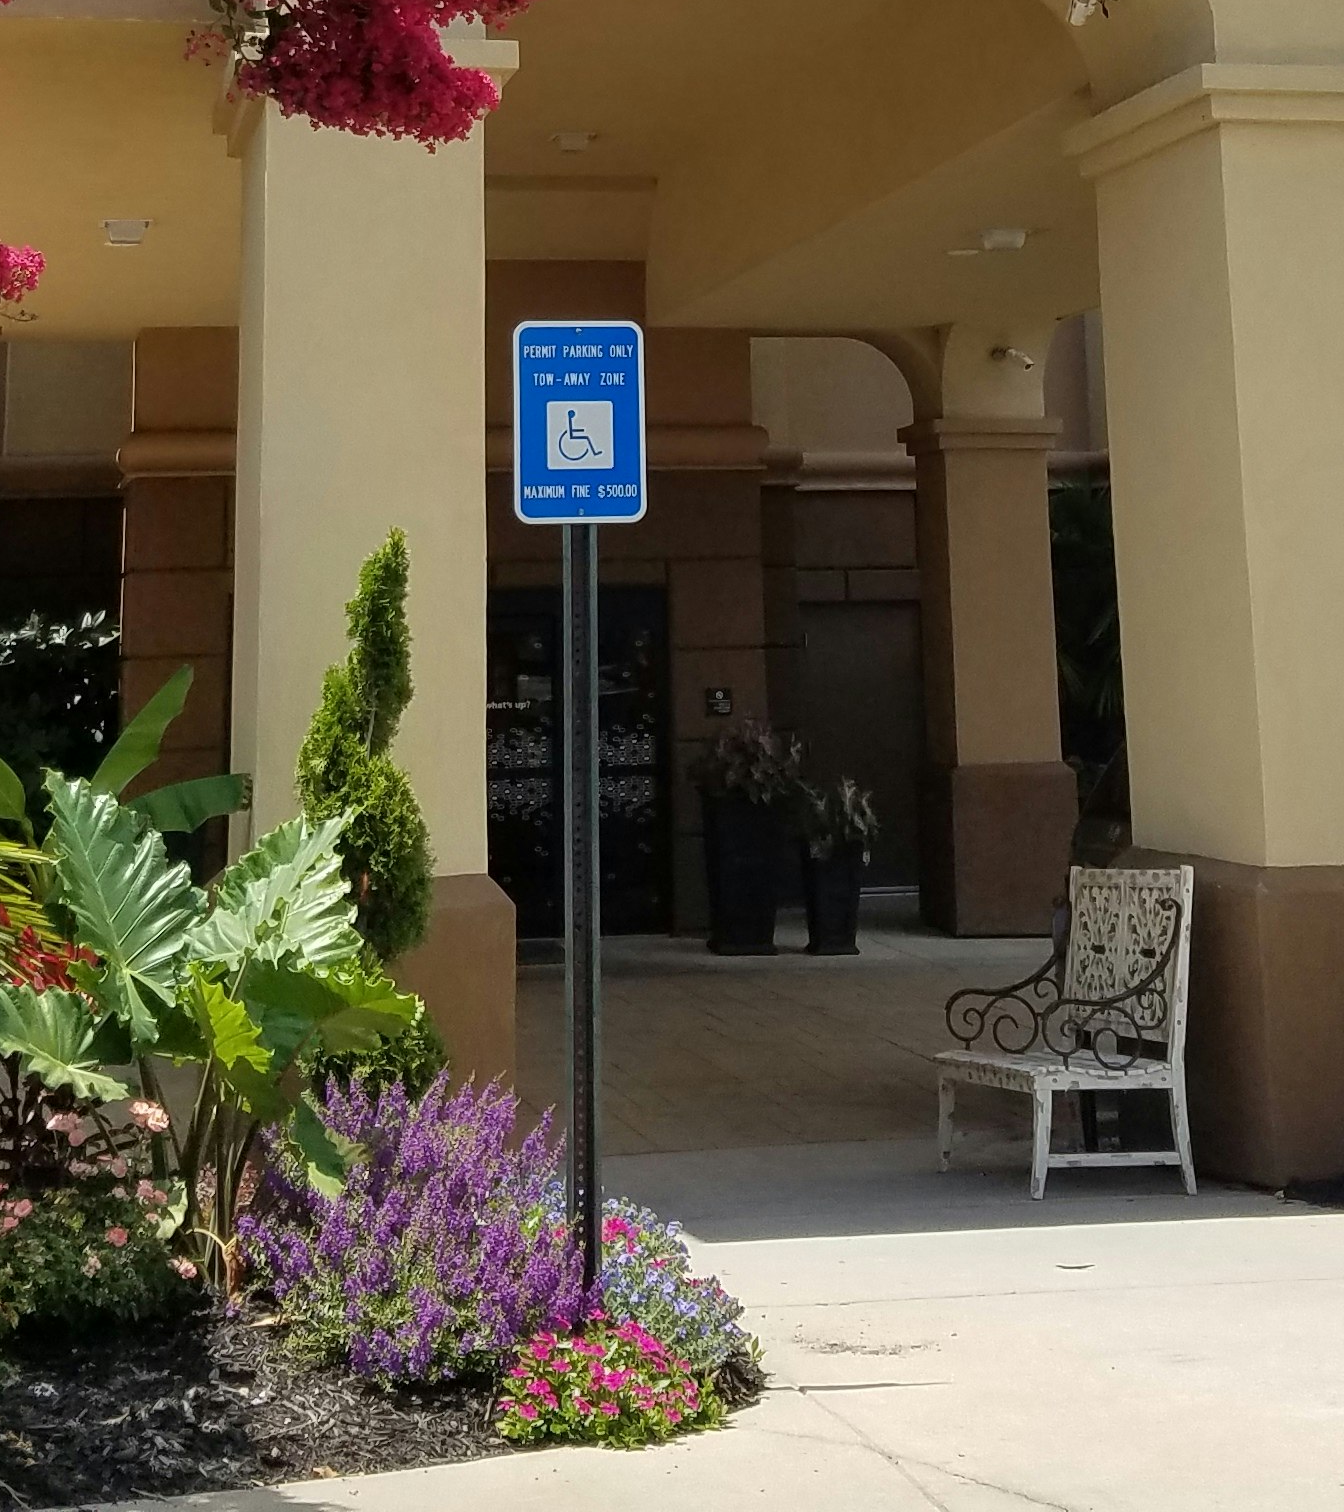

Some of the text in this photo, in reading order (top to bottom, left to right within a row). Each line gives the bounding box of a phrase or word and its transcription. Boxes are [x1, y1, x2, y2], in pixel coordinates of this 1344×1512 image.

[523, 344, 634, 359] PERMIT PARKING ONLY
[599, 372, 626, 386] ZONE
[523, 484, 638, 499] MAXIMUM FINE $500.00
[514, 699, 531, 711] up?
